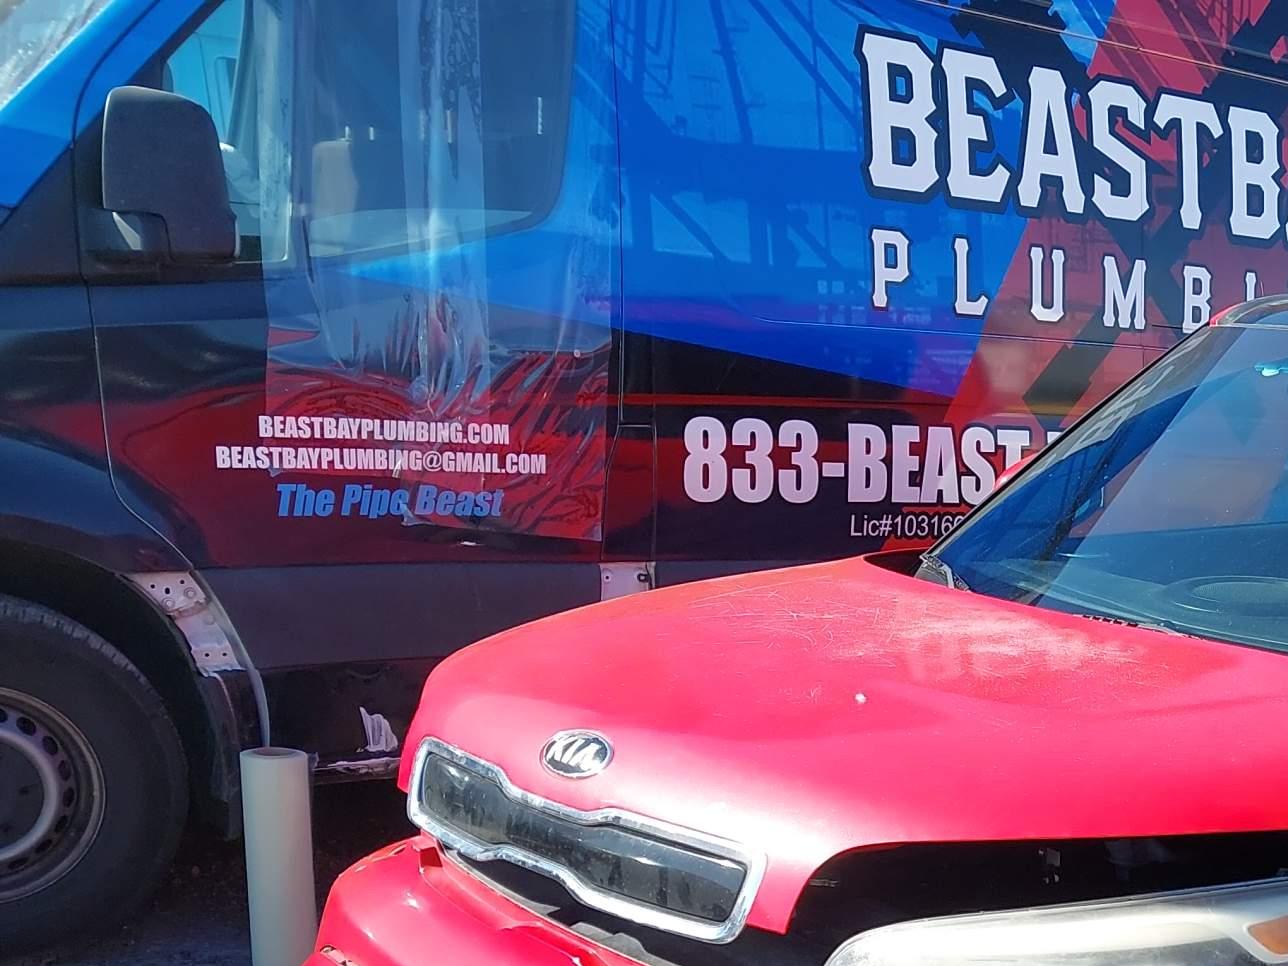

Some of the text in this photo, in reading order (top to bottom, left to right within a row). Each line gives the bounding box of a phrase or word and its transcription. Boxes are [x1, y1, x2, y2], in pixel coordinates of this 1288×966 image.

[258, 415, 510, 445] BEASTBAYPLUMBING.COM
[215, 446, 547, 474] BEASTBAYPLUMBING@GMAIL.COM
[277, 484, 505, 519] The Pipe Beast
[545, 735, 607, 773] KIA
